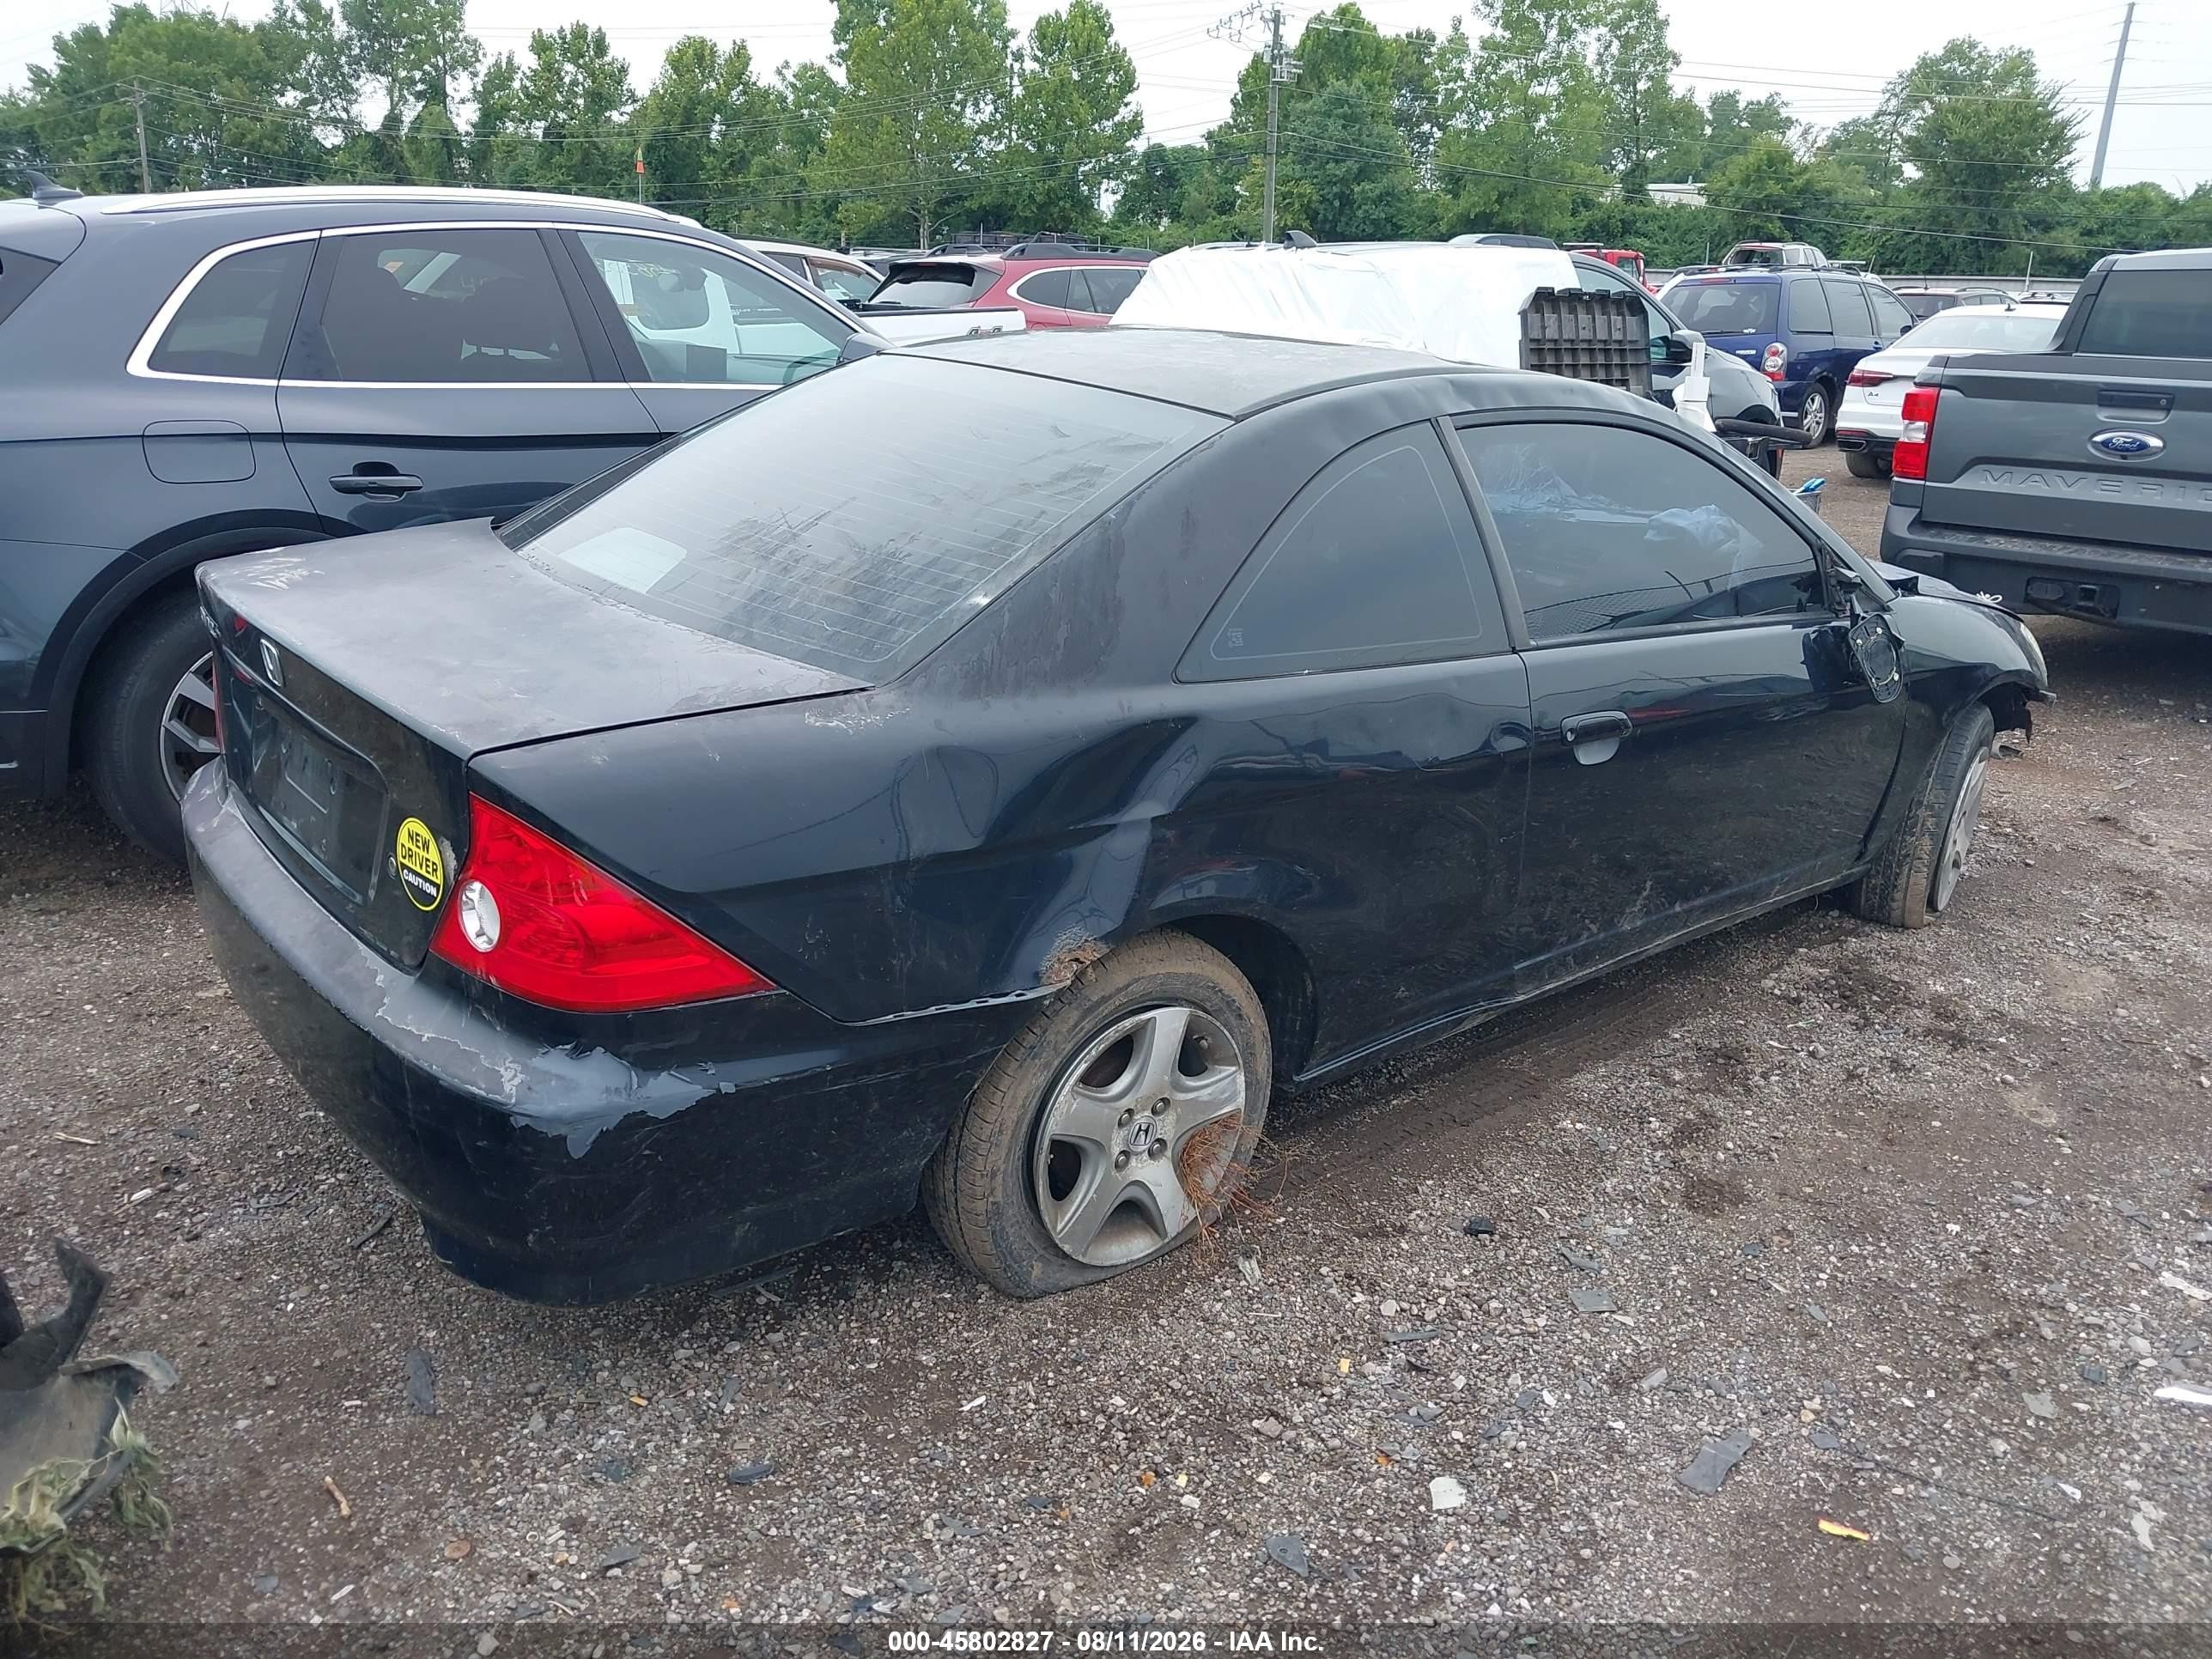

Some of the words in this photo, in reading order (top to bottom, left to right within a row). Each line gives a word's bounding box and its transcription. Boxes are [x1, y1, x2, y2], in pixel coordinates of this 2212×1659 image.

[2108, 436, 2140, 450] Ford
[407, 827, 430, 854] NEW
[400, 842, 439, 880] DRIVER
[403, 868, 437, 897] CAUTION
